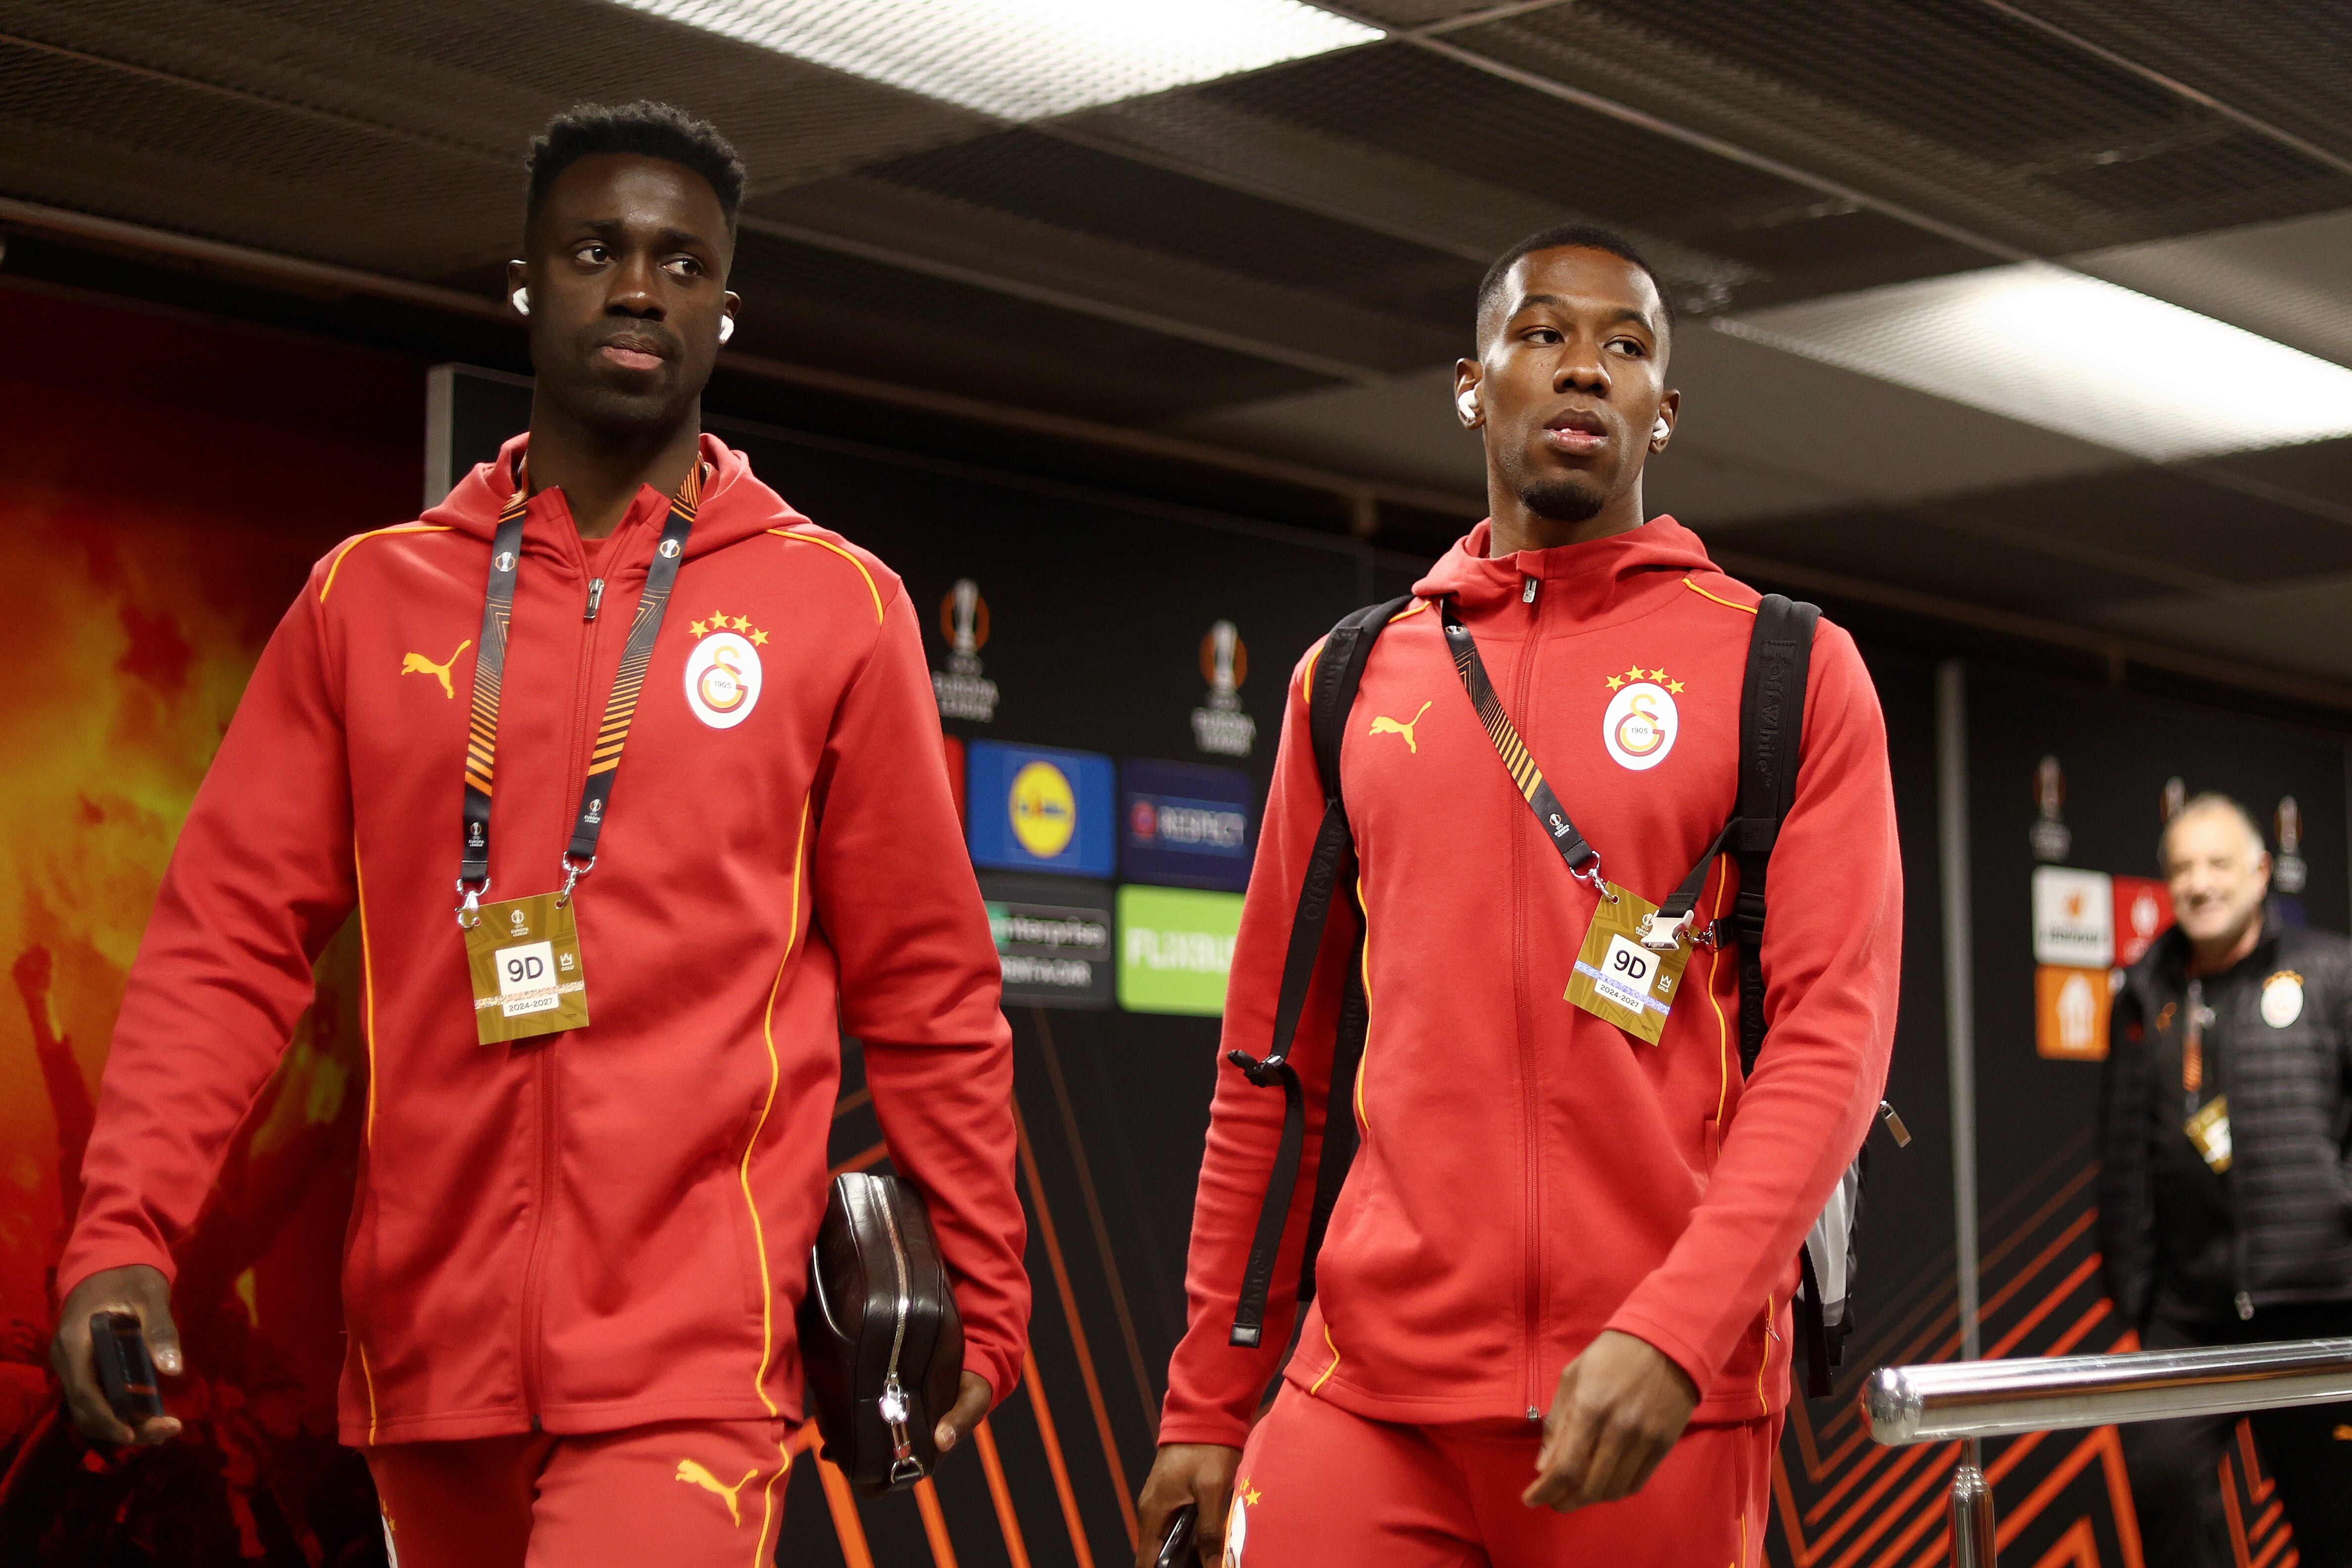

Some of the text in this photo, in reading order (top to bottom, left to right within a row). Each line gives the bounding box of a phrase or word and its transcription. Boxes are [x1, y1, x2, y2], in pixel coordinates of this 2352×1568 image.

[714, 681, 732, 689] 1905
[1635, 926, 1649, 935] EUROP
[507, 956, 543, 982] 9D
[1613, 949, 1646, 979] 9D
[1657, 984, 1669, 993] GOLD
[1600, 984, 1640, 1008] 2024-2027
[509, 998, 553, 1012] 2024-2027
